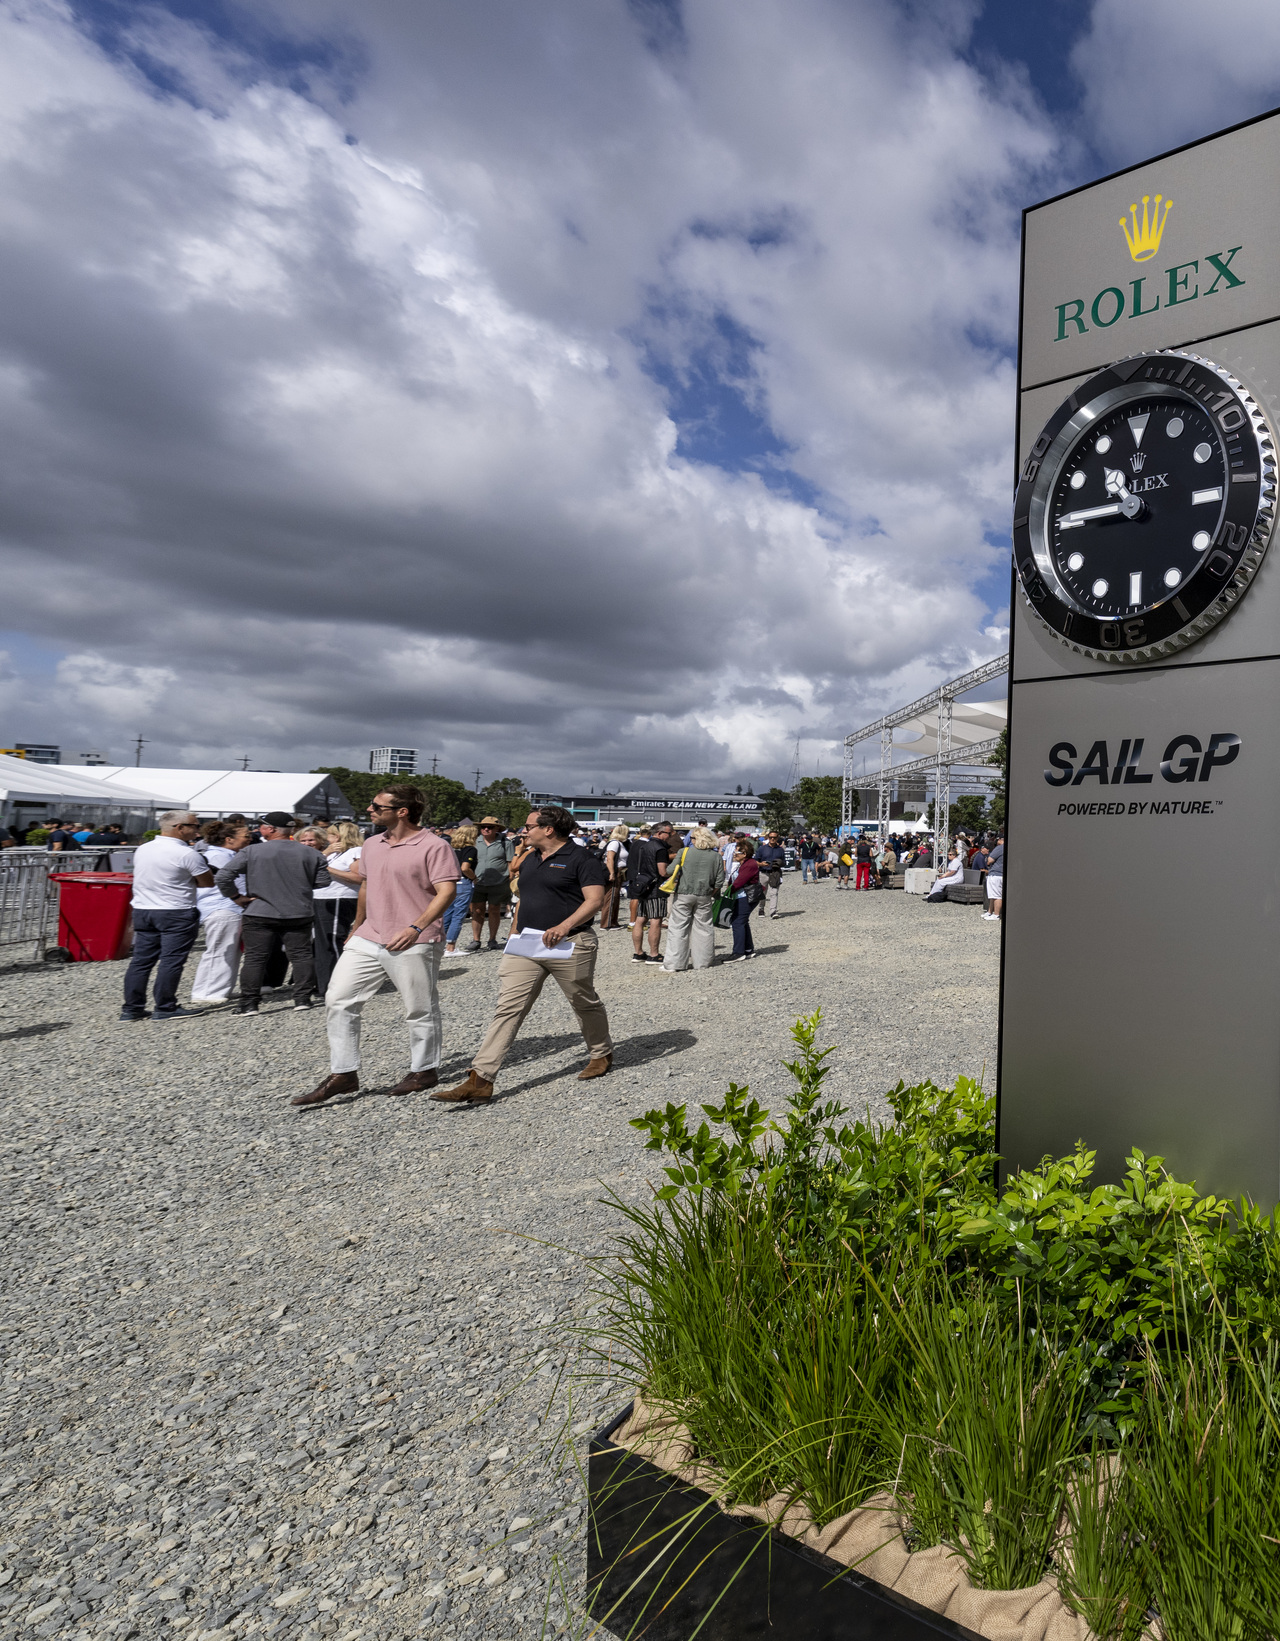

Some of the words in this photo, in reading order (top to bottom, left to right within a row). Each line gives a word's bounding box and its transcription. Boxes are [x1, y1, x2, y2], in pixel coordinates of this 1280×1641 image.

[1053, 246, 1246, 342] ROLEX
[1209, 391, 1247, 433] 10
[1106, 473, 1170, 499] LEX
[1205, 520, 1249, 578] 20
[631, 800, 665, 808] Emirates
[694, 801, 715, 809] NEW
[1057, 803, 1125, 816] POWERED
[1128, 802, 1149, 815] BY
